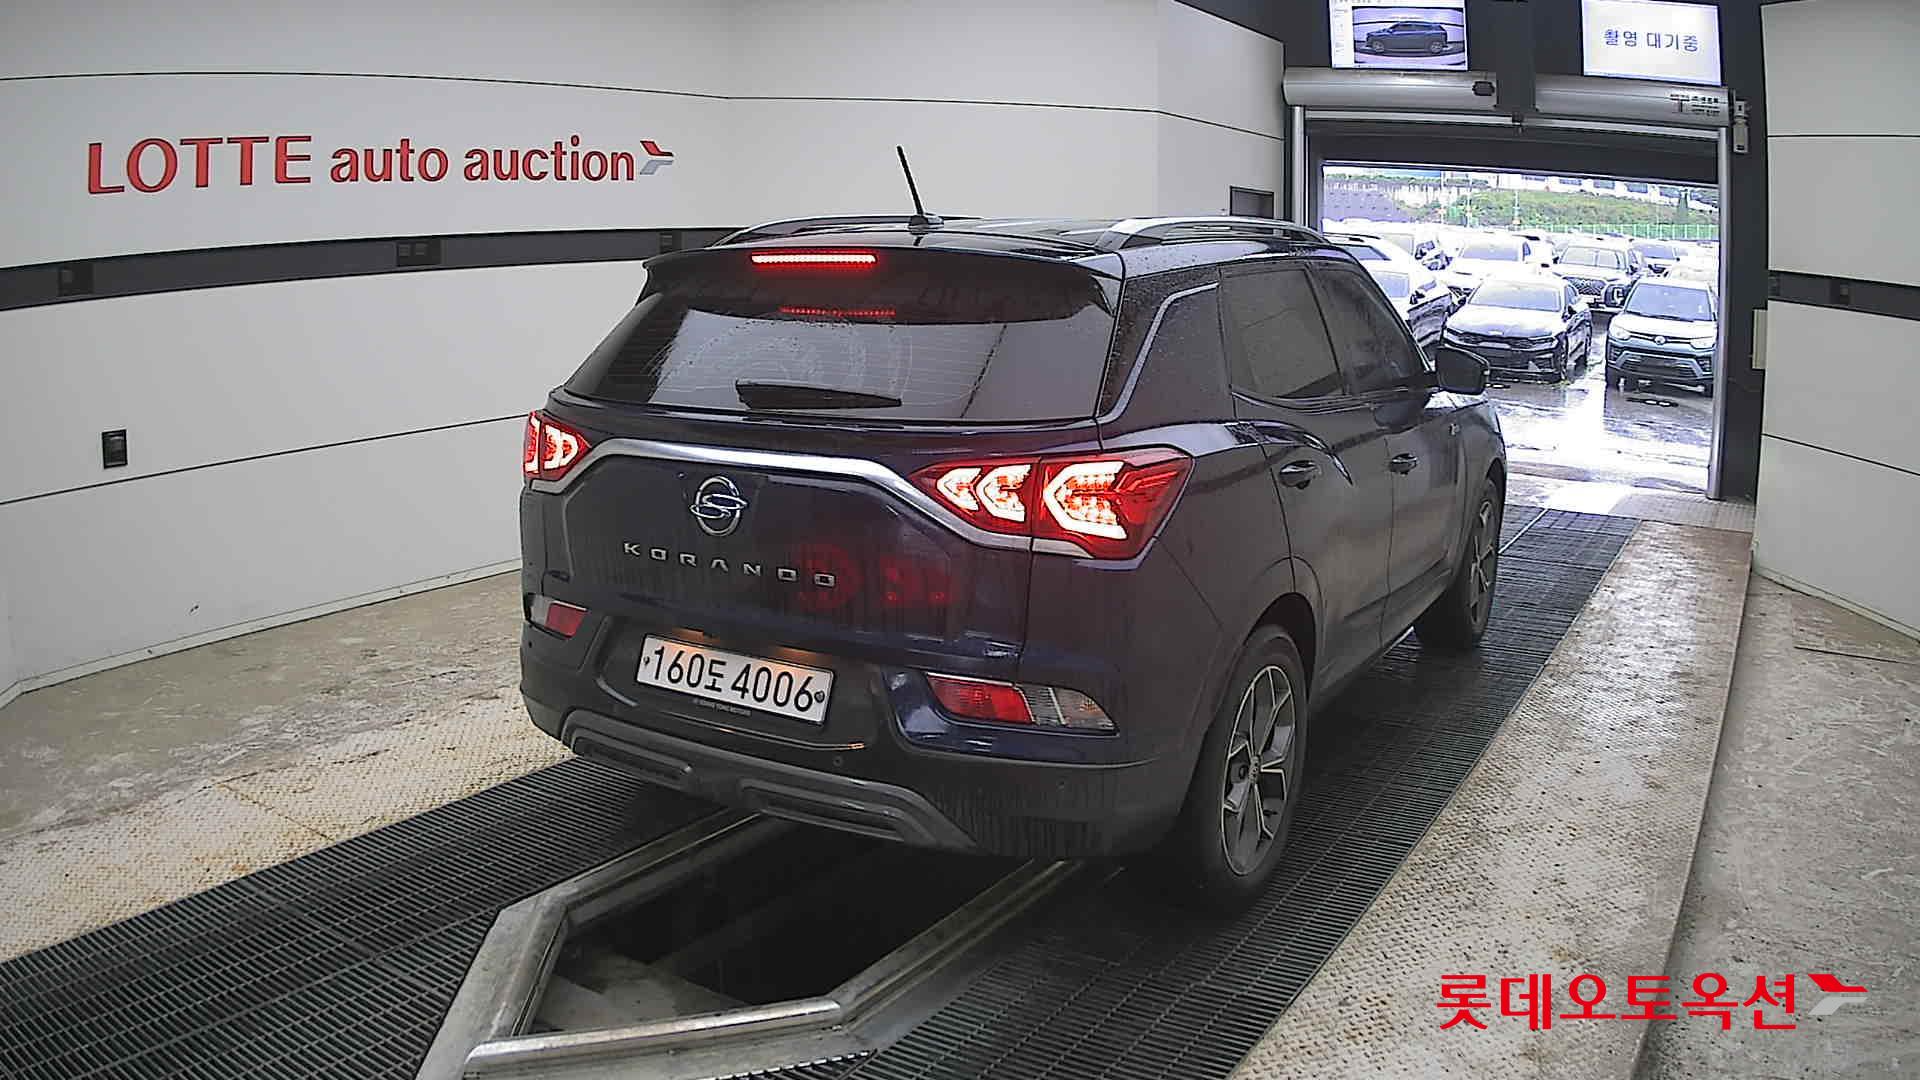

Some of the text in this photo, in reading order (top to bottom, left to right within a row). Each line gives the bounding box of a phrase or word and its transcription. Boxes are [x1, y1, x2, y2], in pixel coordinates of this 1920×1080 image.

[1646, 32, 1698, 52] 대기중
[87, 135, 635, 194] LOTTE auto auction
[624, 542, 836, 588] KORANDO
